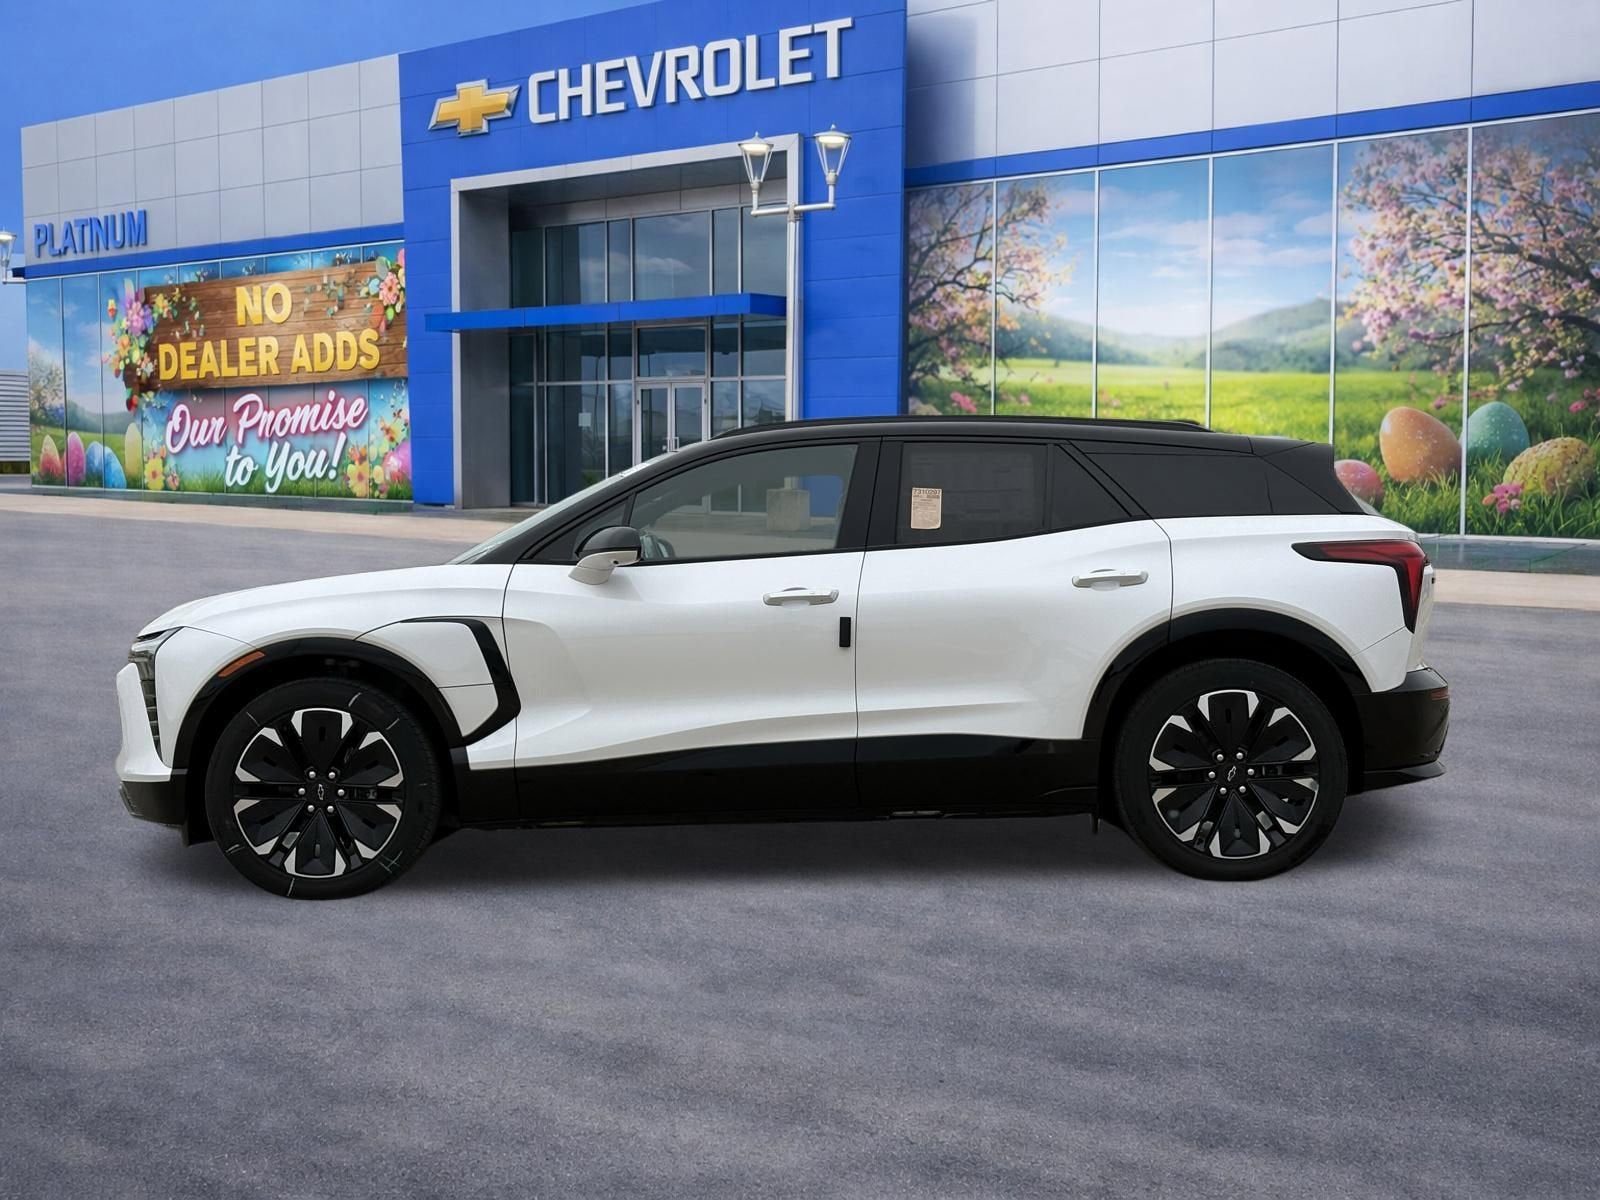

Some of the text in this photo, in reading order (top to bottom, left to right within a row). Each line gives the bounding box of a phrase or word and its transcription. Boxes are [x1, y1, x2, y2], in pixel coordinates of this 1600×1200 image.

[528, 17, 853, 125] CHEVROLET
[34, 209, 148, 258] PLATINUM
[235, 282, 292, 326] NO
[158, 328, 381, 380] DEALER ADDS
[166, 390, 368, 452] Our Promise
[224, 432, 347, 494] to You!
